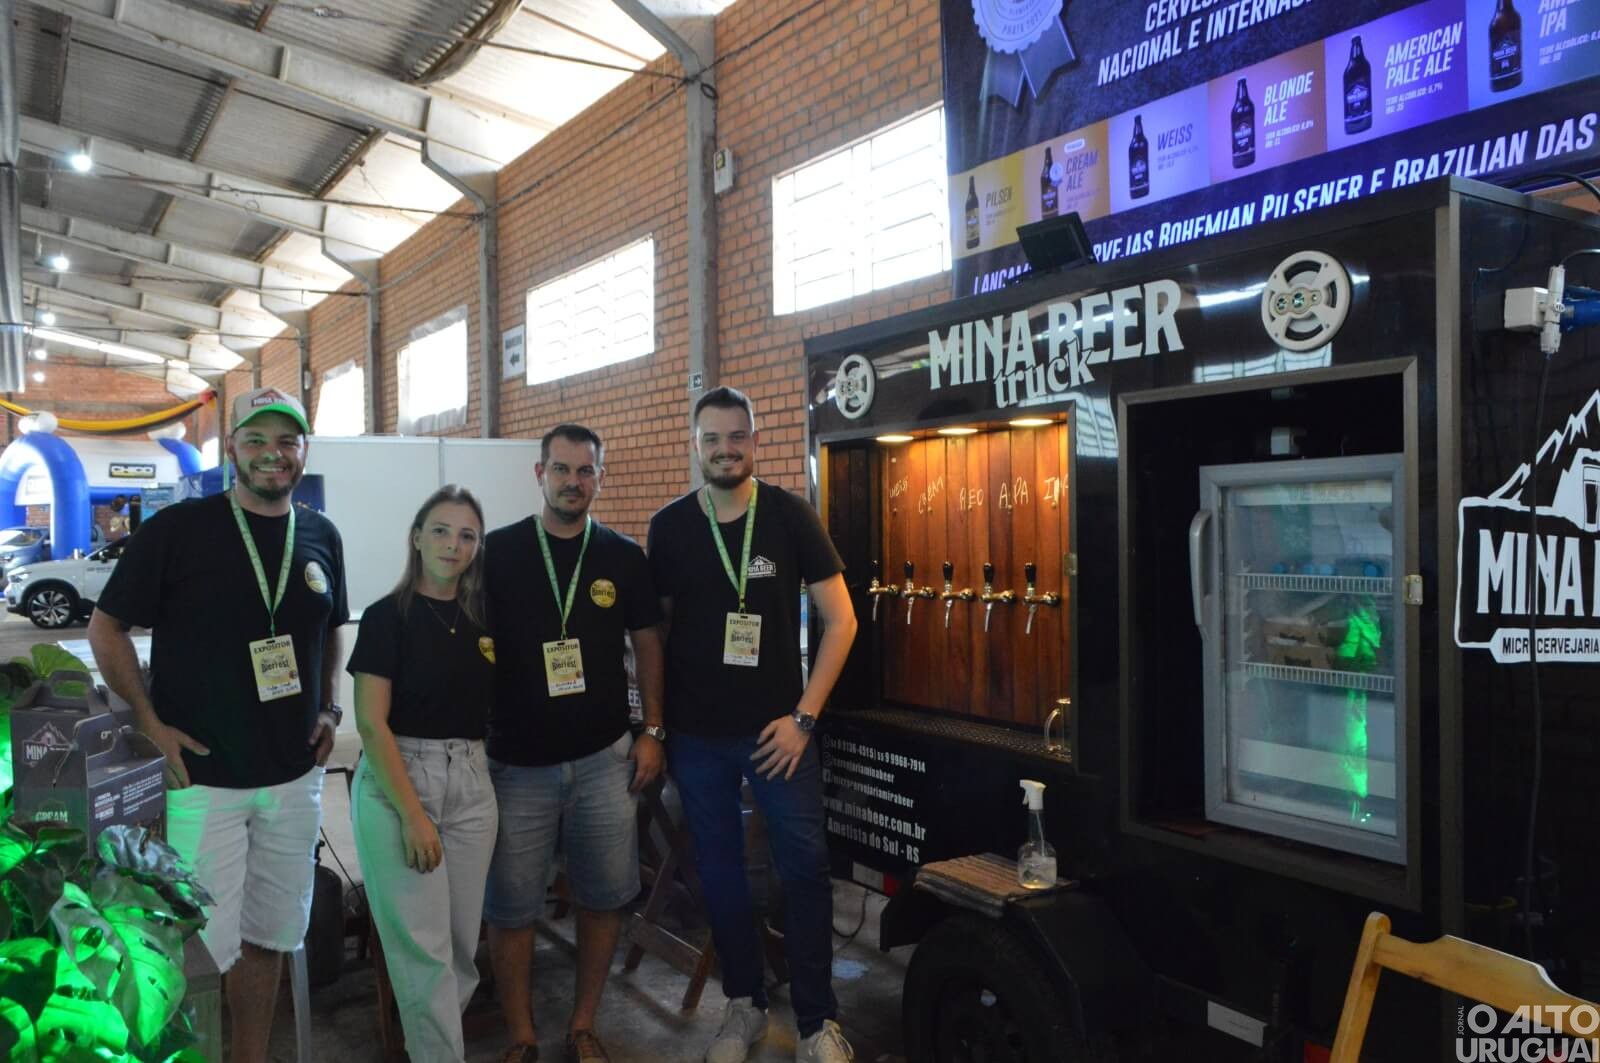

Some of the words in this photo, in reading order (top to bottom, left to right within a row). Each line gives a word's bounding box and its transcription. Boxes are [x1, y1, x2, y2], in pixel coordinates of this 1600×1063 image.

[1540, 7, 1567, 38] IPA
[1098, 26, 1182, 86] NACIONAL
[1188, 18, 1202, 50] E
[1384, 21, 1463, 68] AMERICAN
[1385, 58, 1423, 89] PALE
[1423, 47, 1454, 78] ALE
[1264, 71, 1315, 107] BLONDE
[1264, 100, 1288, 127] ALE
[1157, 123, 1194, 151] WEISS
[1066, 149, 1098, 175] CREAM
[1159, 202, 1256, 249] BOHEMIAN
[1392, 130, 1529, 189] BRAZILIAN
[1535, 113, 1598, 161] DAS
[985, 186, 1013, 209] PILSEN
[1067, 171, 1084, 193] ALE
[928, 310, 1036, 391] MINA
[1047, 279, 1185, 365] BEER
[994, 336, 1096, 409] truck
[1476, 528, 1585, 617] MINA
[254, 640, 290, 654] EXPOSITOR
[1502, 636, 1600, 655] MICRCERVEJARIA
[822, 795, 926, 841] www.minabeer.com.br
[827, 816, 867, 845] Ametista
[868, 831, 881, 849] do
[882, 836, 899, 856] Sul
[906, 844, 920, 863] RS
